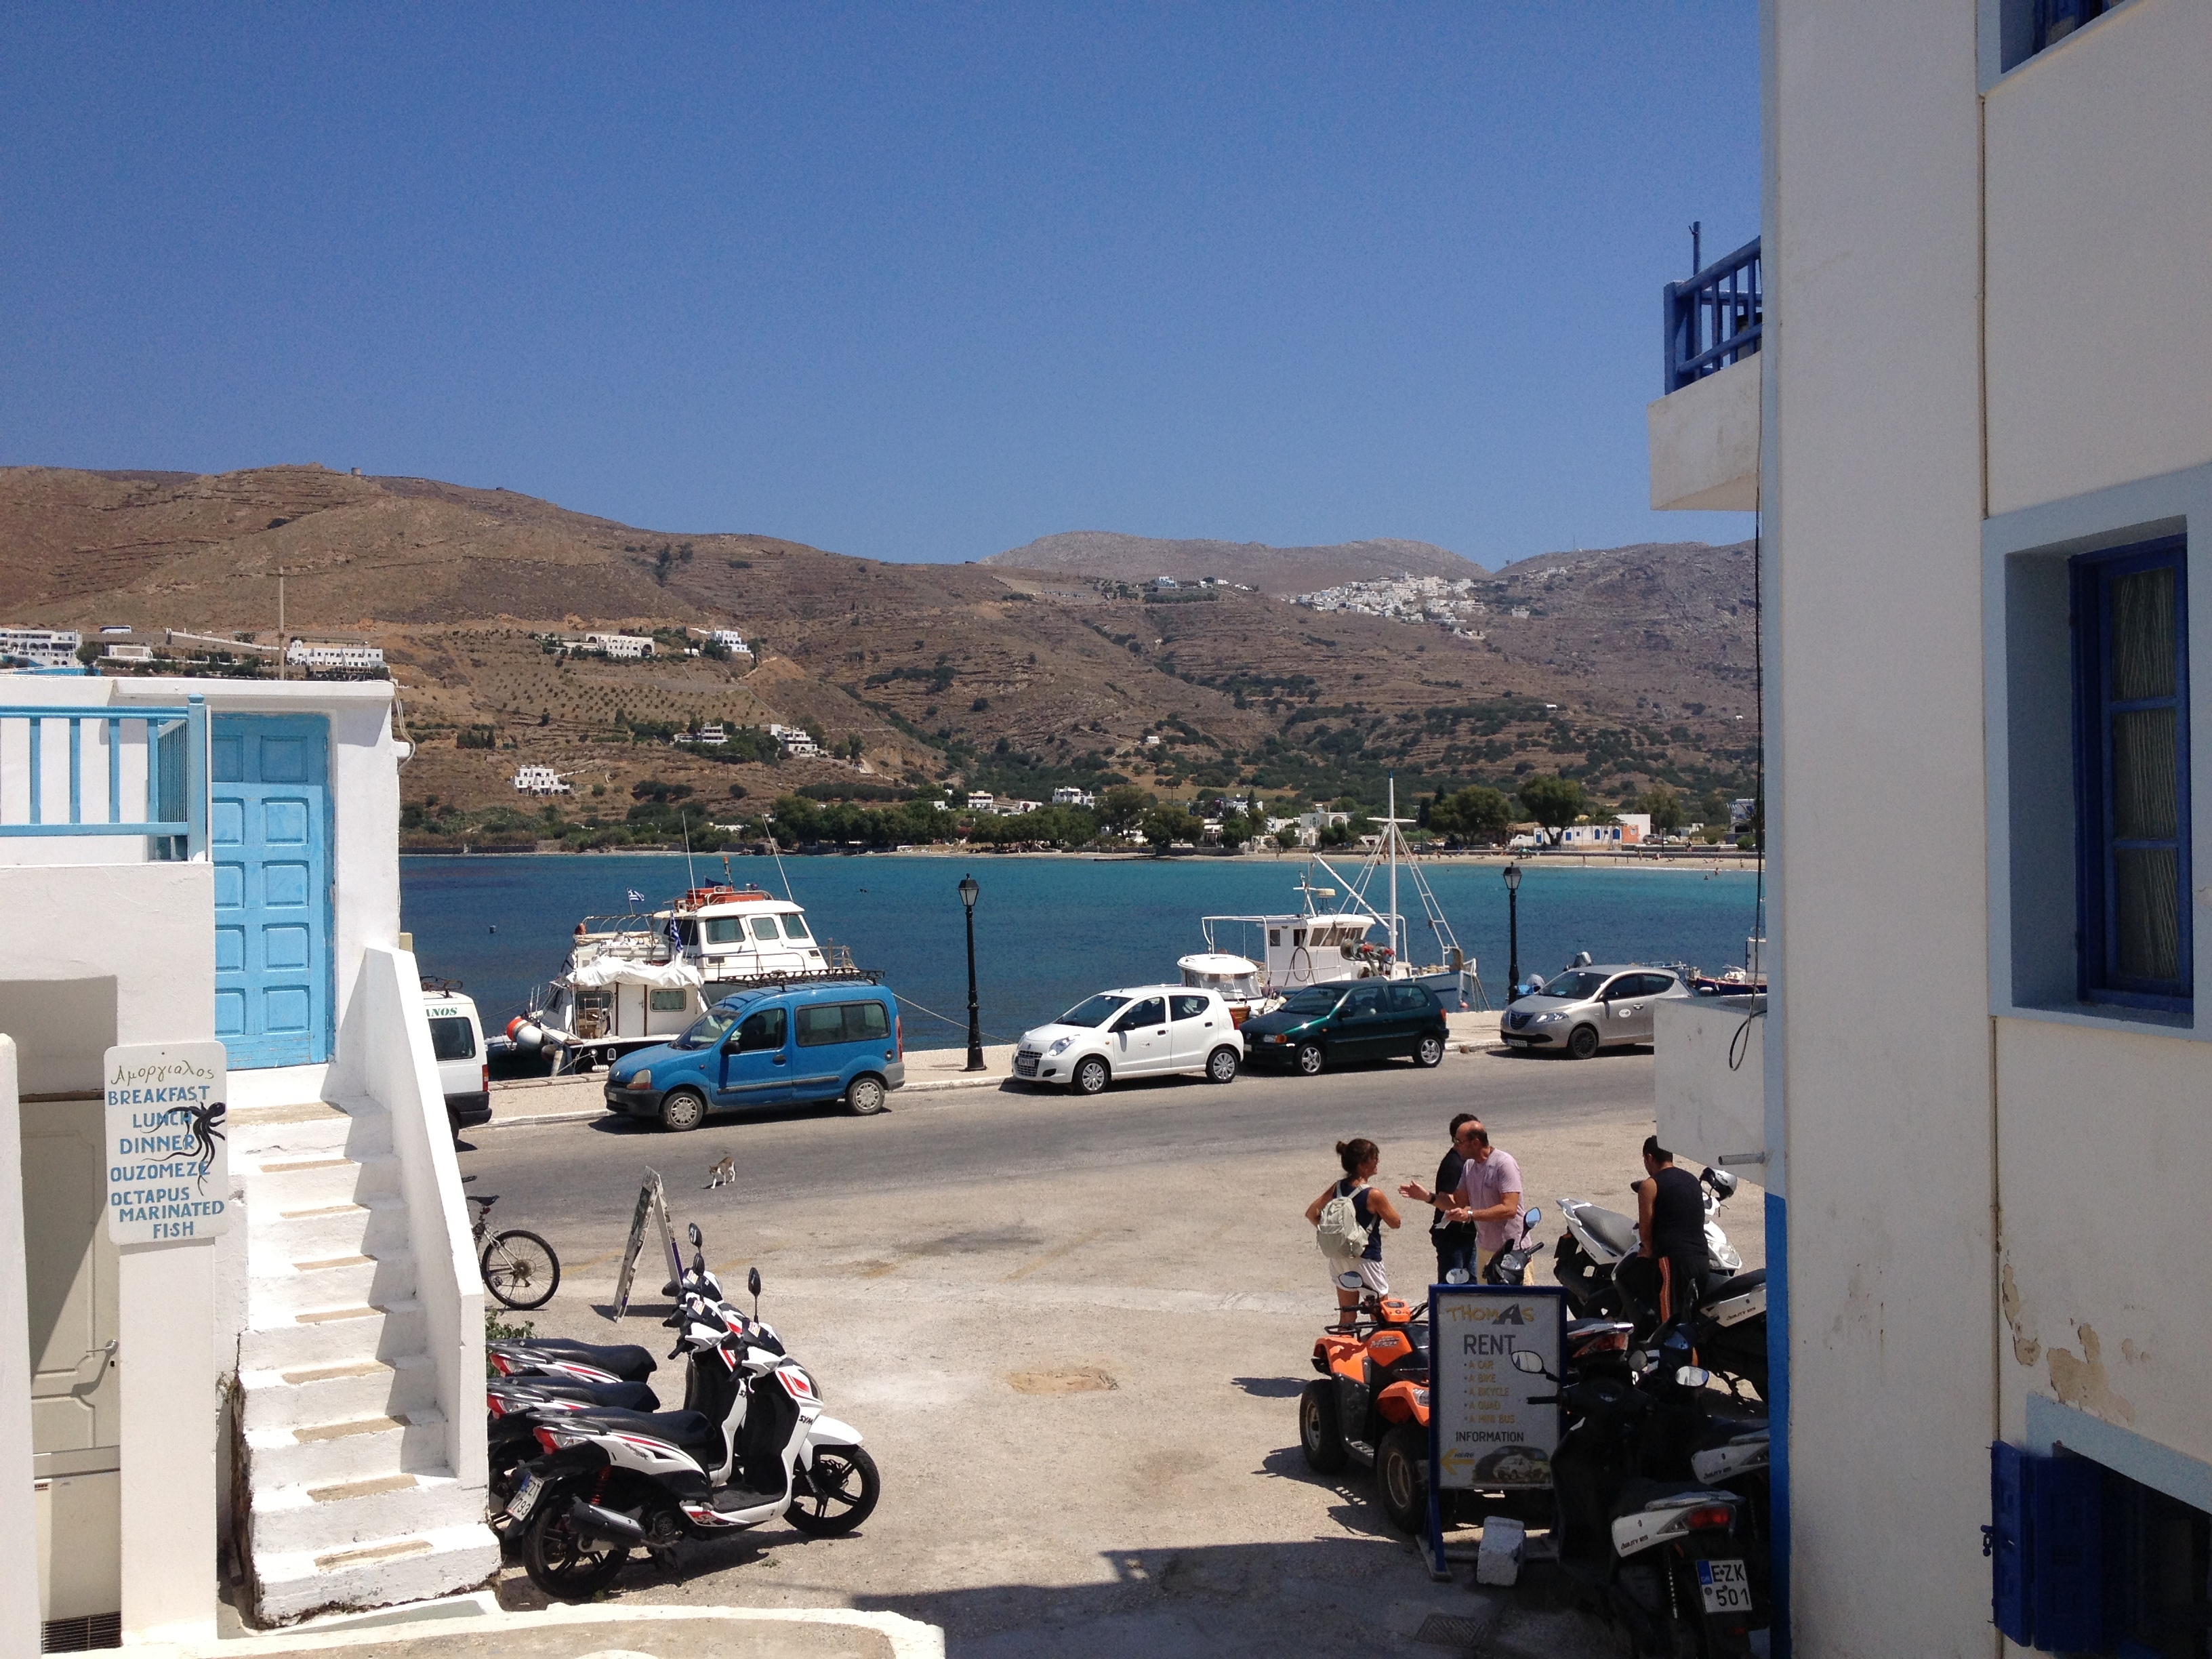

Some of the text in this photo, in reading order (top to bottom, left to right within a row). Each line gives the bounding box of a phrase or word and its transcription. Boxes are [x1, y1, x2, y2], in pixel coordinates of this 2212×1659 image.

[108, 1086, 210, 1105] BREAKFAST
[133, 1111, 192, 1128] LUNCH
[120, 1134, 195, 1155] DINNER
[111, 1187, 190, 1206] OCTAPUS
[119, 1200, 224, 1223] MARINATED
[153, 1221, 194, 1239] FISH
[1446, 1303, 1534, 1325] THOMAS
[1464, 1334, 1516, 1355] RENT
[1469, 1360, 1494, 1369] A CAR
[1469, 1374, 1496, 1382] A BIKE
[1478, 1387, 1509, 1396] BICYCLE
[1478, 1401, 1501, 1410] QUAD
[1498, 1414, 1515, 1424] BUS
[1455, 1431, 1524, 1442] INFORMATION
[513, 1497, 531, 1516] 793
[1711, 1564, 1745, 1582] EZK
[1716, 1588, 1748, 1606] 501
